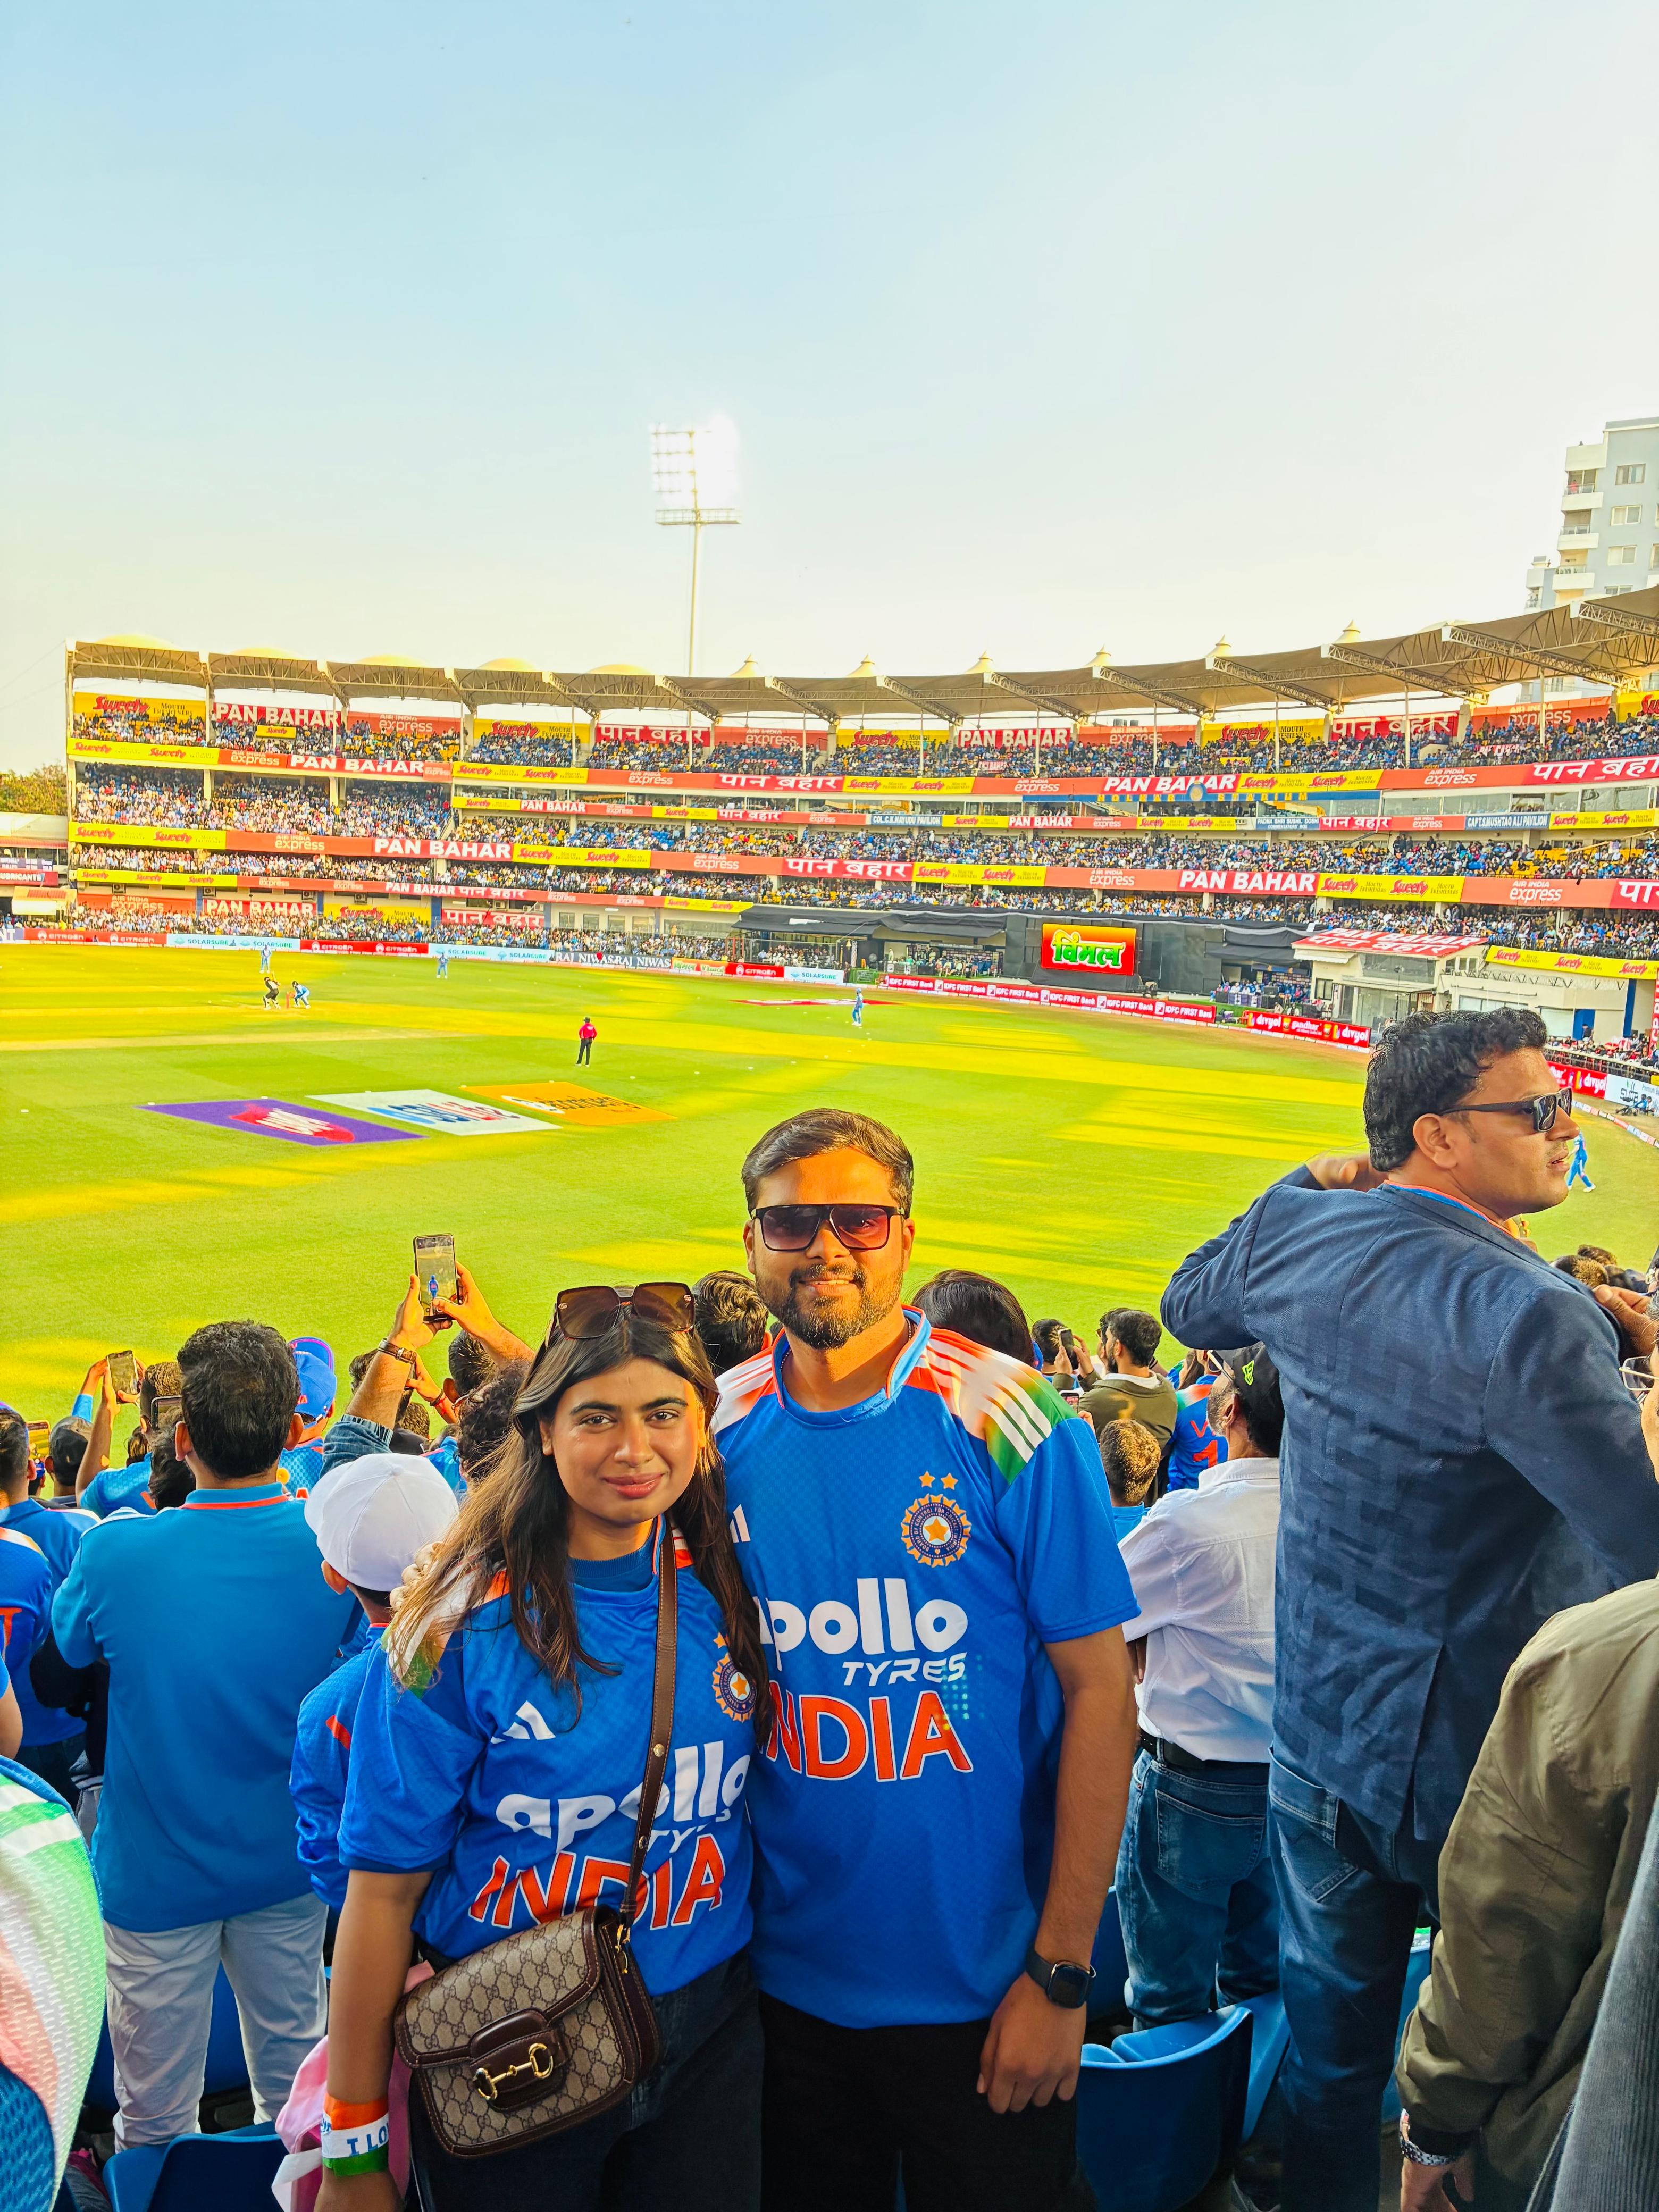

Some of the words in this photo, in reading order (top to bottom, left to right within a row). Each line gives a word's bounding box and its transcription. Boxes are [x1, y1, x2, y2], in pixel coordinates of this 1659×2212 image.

[93, 696, 150, 713] Sweety
[216, 703, 257, 721] PAN
[266, 707, 342, 727] BAHAR
[379, 720, 433, 732] express
[490, 721, 540, 738] Sweety
[1332, 718, 1381, 737] पान
[1386, 712, 1458, 732] बहार
[600, 726, 644, 740] पान
[648, 726, 708, 745] बहार
[851, 731, 900, 748] Sweety
[961, 730, 995, 748] PAN
[1002, 729, 1068, 749] BAHAR
[1220, 724, 1270, 743] Sweety
[746, 734, 797, 748] express
[231, 755, 279, 765] express
[290, 755, 337, 769] PAN
[345, 759, 424, 774] BAHAR
[1534, 761, 1595, 780] पान
[1602, 757, 1659, 777] बहा
[629, 776, 673, 785] express
[719, 774, 771, 787] पान
[776, 776, 843, 790] बहार
[910, 781, 945, 791] Sweety
[1104, 777, 1151, 791] PAN
[1241, 777, 1278, 789] Sweety
[1308, 775, 1347, 787] Sweety
[1424, 774, 1477, 786] express
[1015, 783, 1060, 793] express
[521, 801, 543, 810] PAN
[547, 801, 585, 812] BAHAR
[719, 810, 745, 819] पान
[748, 810, 782, 821] बहार
[1009, 817, 1031, 826] PAN
[1034, 817, 1073, 827] BAHAR
[1513, 816, 1522, 826] ALI
[1523, 816, 1547, 826] PAVILION
[1322, 817, 1351, 827] पान
[1355, 817, 1392, 828] बहार
[76, 827, 115, 839] Sweety
[154, 831, 192, 843] Sweety
[275, 839, 325, 850] express
[374, 839, 421, 854] PAN
[430, 841, 512, 859] BAHAR
[517, 848, 553, 861] Sweety
[585, 852, 619, 864] Sweety
[694, 859, 739, 870] express
[785, 858, 838, 874] पान
[843, 860, 913, 878] बहार
[916, 866, 950, 878] Sweety
[981, 868, 1016, 882] Sweety
[1090, 875, 1135, 887] express
[1179, 871, 1226, 889] PAN
[1233, 873, 1316, 892] BAHAR
[1320, 878, 1358, 894] Sweety
[386, 882, 409, 892] PAN
[413, 884, 455, 895] BAHAR
[458, 887, 488, 896] पान
[490, 887, 527, 899] बहार
[1389, 879, 1429, 897] Sweety
[1510, 887, 1563, 903] express
[207, 899, 243, 915] PAN
[249, 901, 313, 918] BAHAR
[444, 909, 488, 924] पान
[490, 912, 544, 929] बहार
[1322, 928, 1380, 939] PAN
[1378, 933, 1476, 945] BAHAR
[1050, 929, 1126, 969] विमल
[1309, 935, 1371, 946] पान
[1372, 942, 1459, 954] बहार
[556, 952, 574, 962] RAJ
[579, 953, 613, 965] NIWAS
[615, 956, 632, 967] RAJ
[637, 957, 671, 968] NIWAS
[1494, 949, 1521, 962] Sweety
[1555, 957, 1583, 969] Sweety
[1619, 962, 1648, 975] Sweety
[802, 971, 836, 980] SOLARSURE
[1010, 988, 1026, 997] FIRST
[1050, 993, 1063, 1001] IDFC
[1063, 994, 1080, 1003] FIRST
[1081, 995, 1095, 1004] Bank
[1121, 1001, 1138, 1010] FIRST
[1138, 1003, 1153, 1012] Bank
[1166, 1006, 1179, 1014] IDFC
[1180, 1007, 1198, 1016] FIRST
[1256, 1015, 1281, 1029] divyol
[1342, 1025, 1368, 1043] divyol
[1584, 1073, 1607, 1094] divyol
[842, 1652, 968, 1687] TYRES
[766, 1680, 973, 1782] NDIA
[468, 1833, 726, 1931] INDIA
